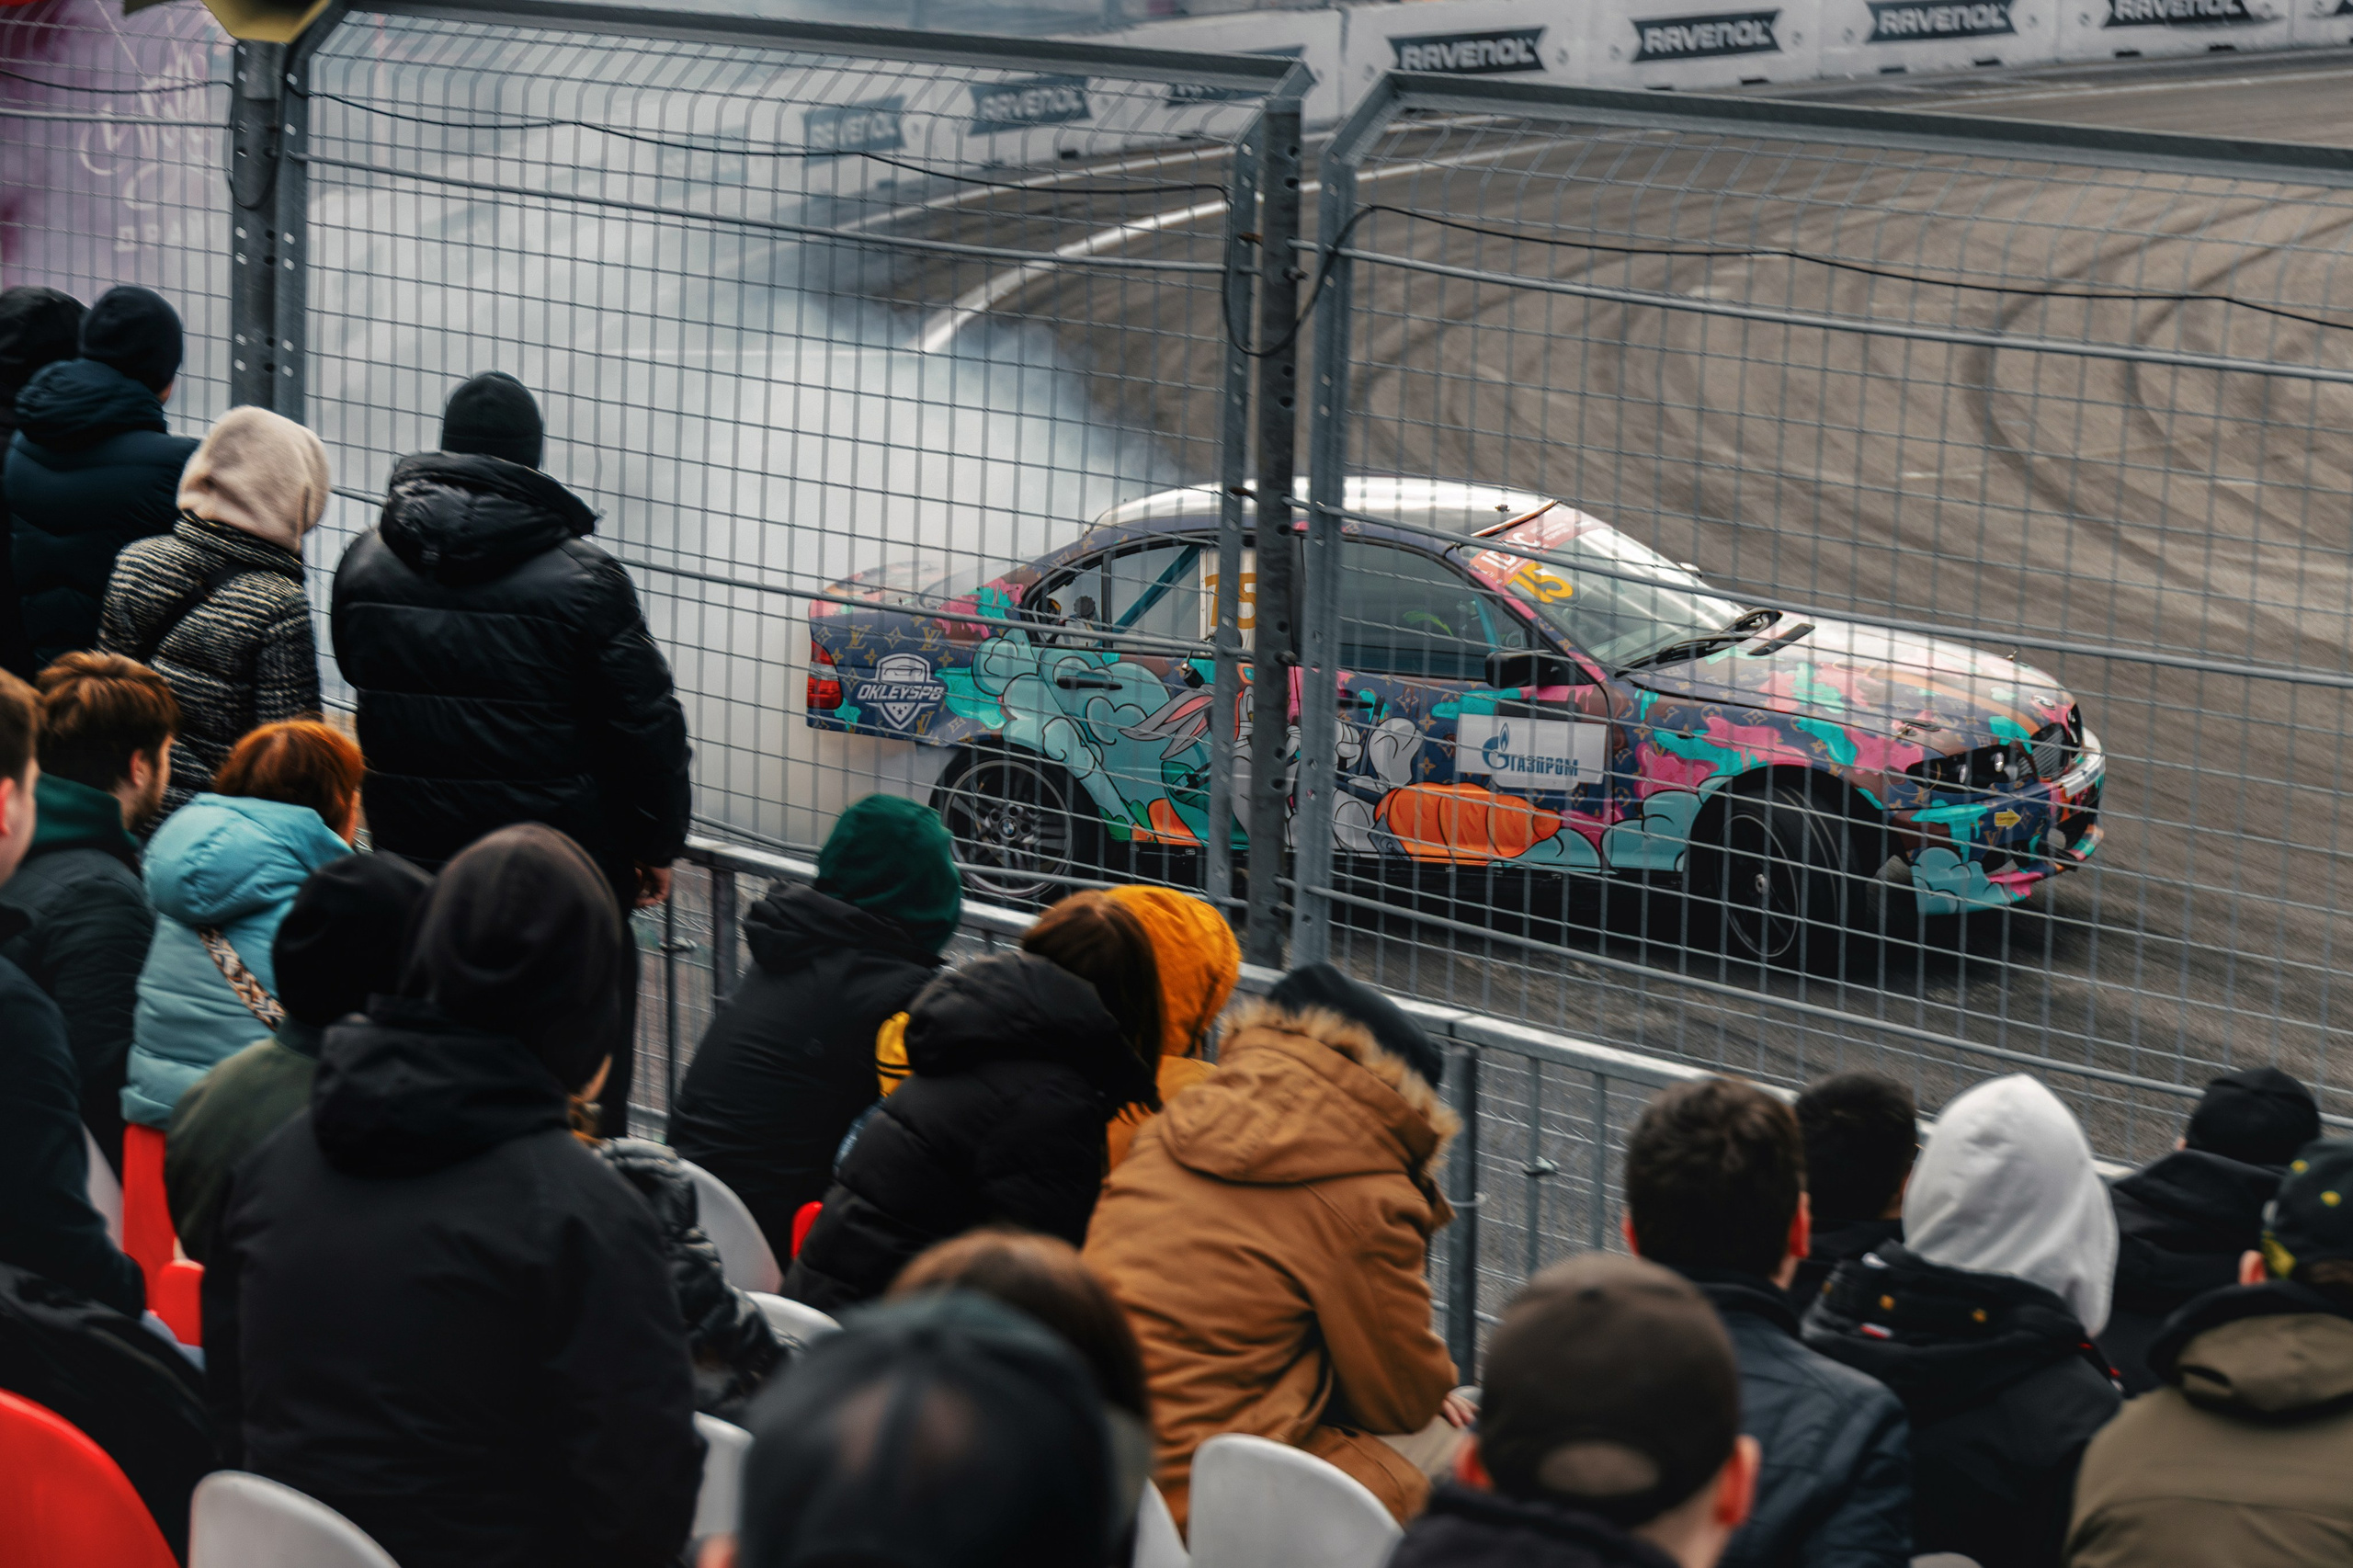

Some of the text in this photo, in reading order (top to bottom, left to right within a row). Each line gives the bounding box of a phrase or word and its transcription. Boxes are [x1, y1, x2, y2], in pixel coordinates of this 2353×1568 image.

[1879, 4, 2007, 34] RAVENOL
[1643, 19, 1771, 53] RAVENOL
[1400, 38, 1536, 70] RAVENOL
[1507, 562, 1574, 604] 15
[857, 684, 944, 701] OKLEYSPB
[1510, 756, 1579, 777] ГАЗПРОМ
